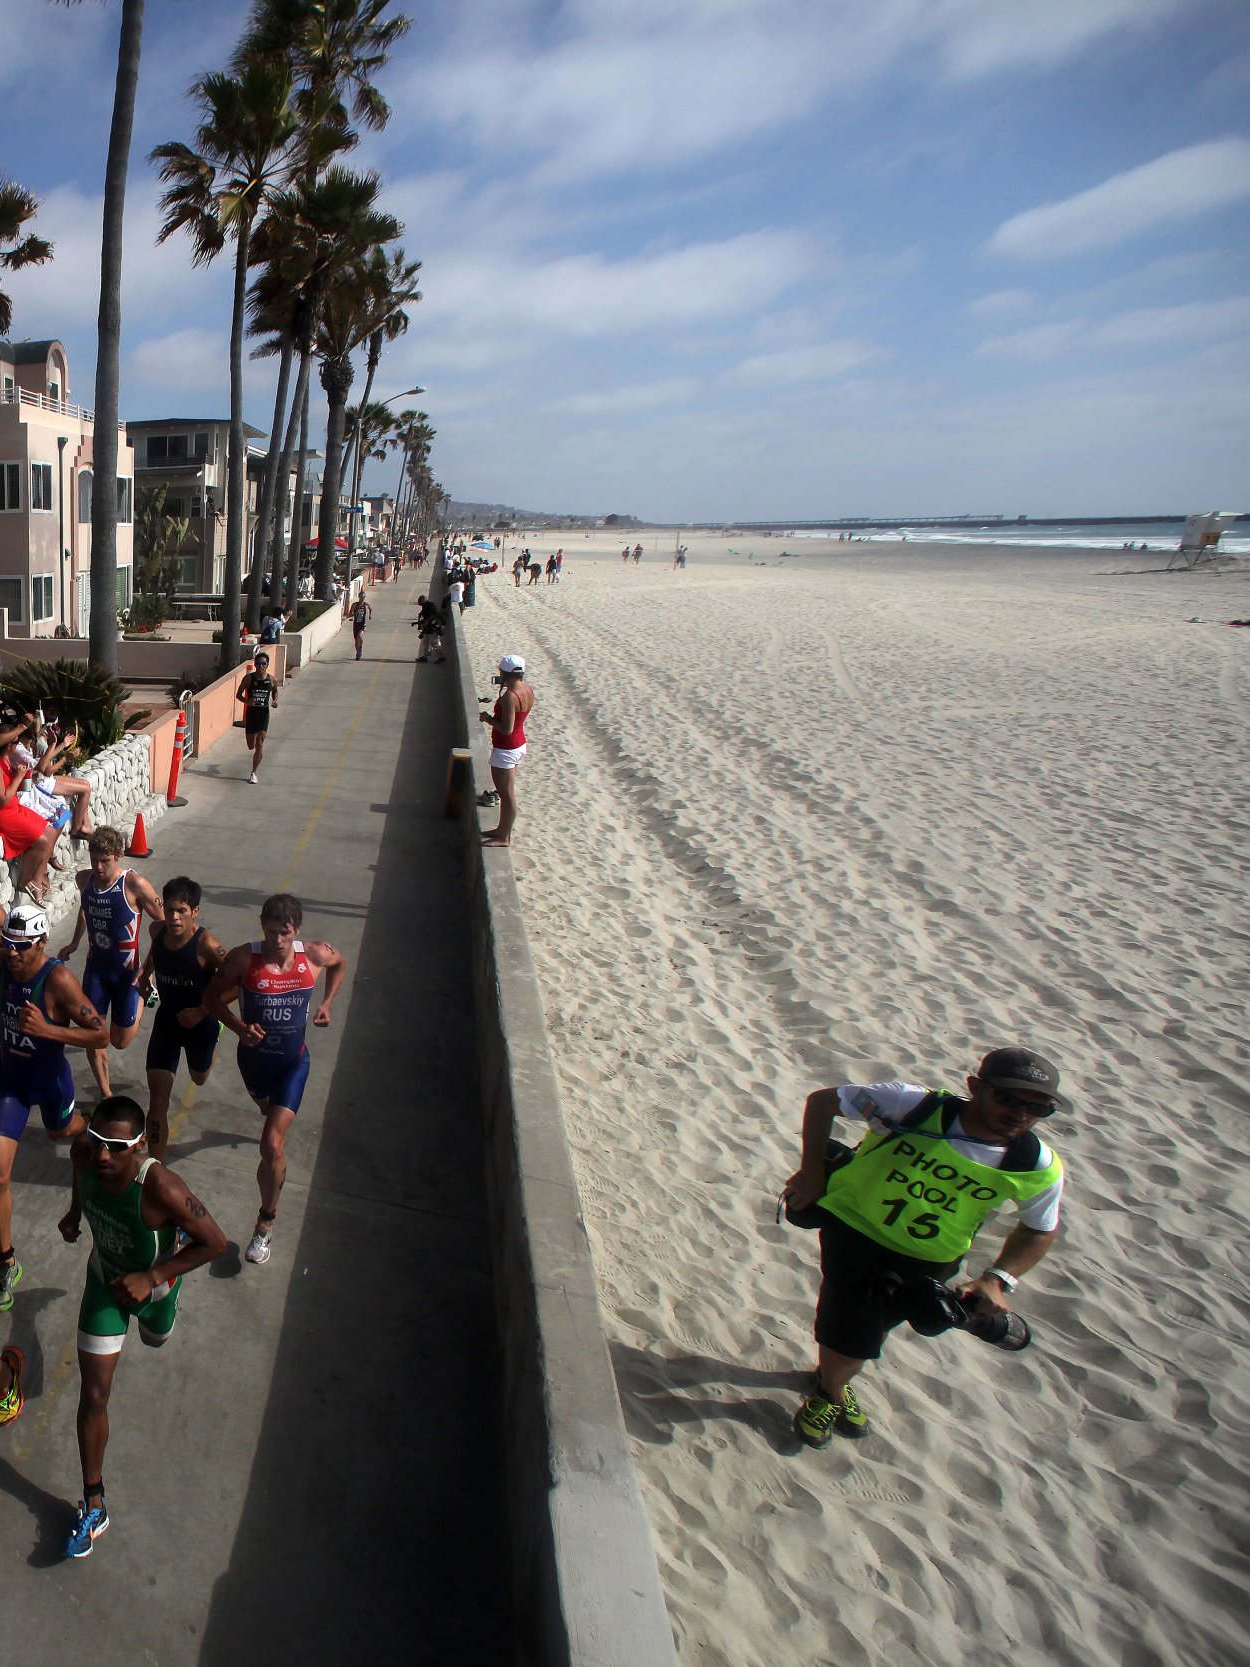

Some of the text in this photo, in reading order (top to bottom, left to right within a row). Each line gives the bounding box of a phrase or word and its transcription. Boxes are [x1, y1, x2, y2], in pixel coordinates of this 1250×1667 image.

[93, 918, 108, 930] GBR
[22, 987, 32, 995] TYR
[6, 1002, 23, 1015] TY
[254, 995, 304, 1008] Turbaevskiy
[263, 1008, 292, 1022] RUS
[4, 1027, 37, 1051] ITA
[892, 1139, 999, 1201] PHOTO
[884, 1168, 958, 1214] POOL
[880, 1198, 941, 1240] 15
